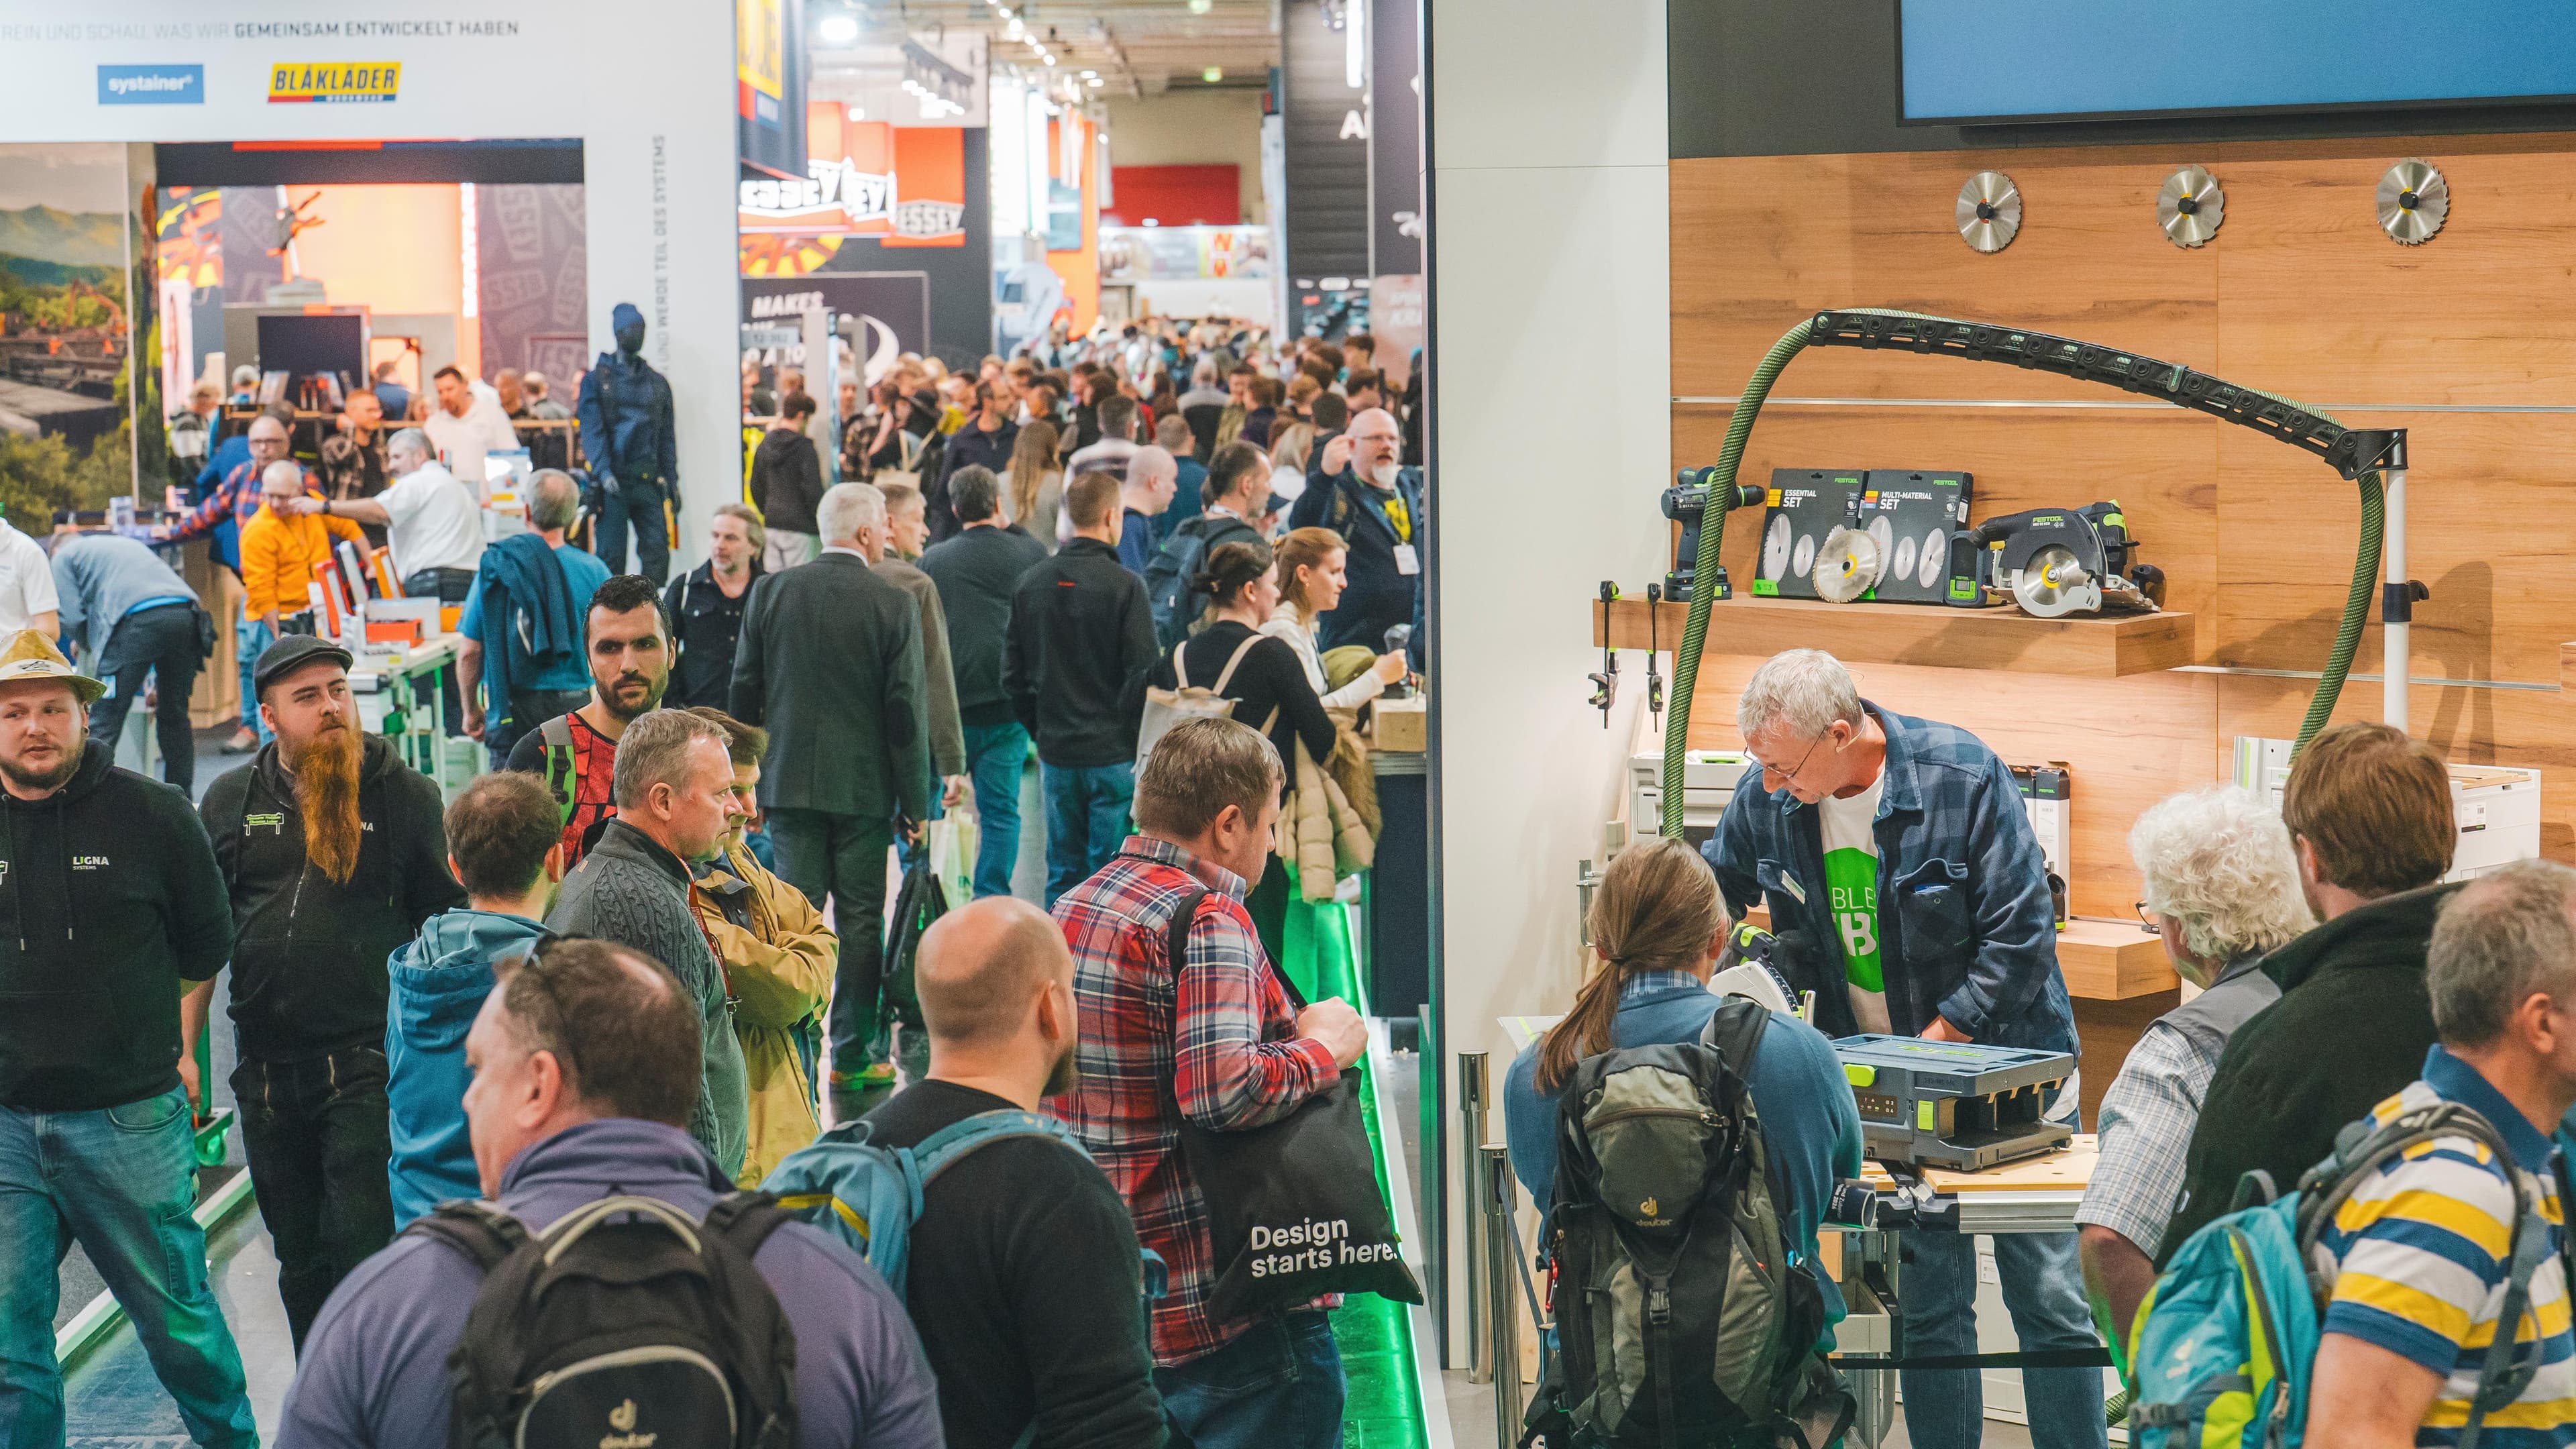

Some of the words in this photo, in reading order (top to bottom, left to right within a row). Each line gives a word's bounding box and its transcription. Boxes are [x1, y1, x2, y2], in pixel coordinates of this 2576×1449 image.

[48, 24, 82, 40] UND
[154, 23, 193, 39] WAS
[197, 23, 230, 39] WIR
[234, 22, 339, 38] GEMEINSAM
[345, 21, 453, 37] ENTWICKELT
[460, 21, 519, 36] HABEN
[1784, 489, 1817, 498] ESSENTIAL
[1881, 491, 1933, 500] MULTI-MATERIAL
[1782, 497, 1803, 508] SET
[1879, 499, 1900, 511] SET
[72, 856, 109, 865] LIGNA
[1635, 1218, 1672, 1227] deuter
[1251, 1217, 1349, 1250] Design
[1251, 1248, 1332, 1278] starts
[1340, 1240, 1398, 1265] here.
